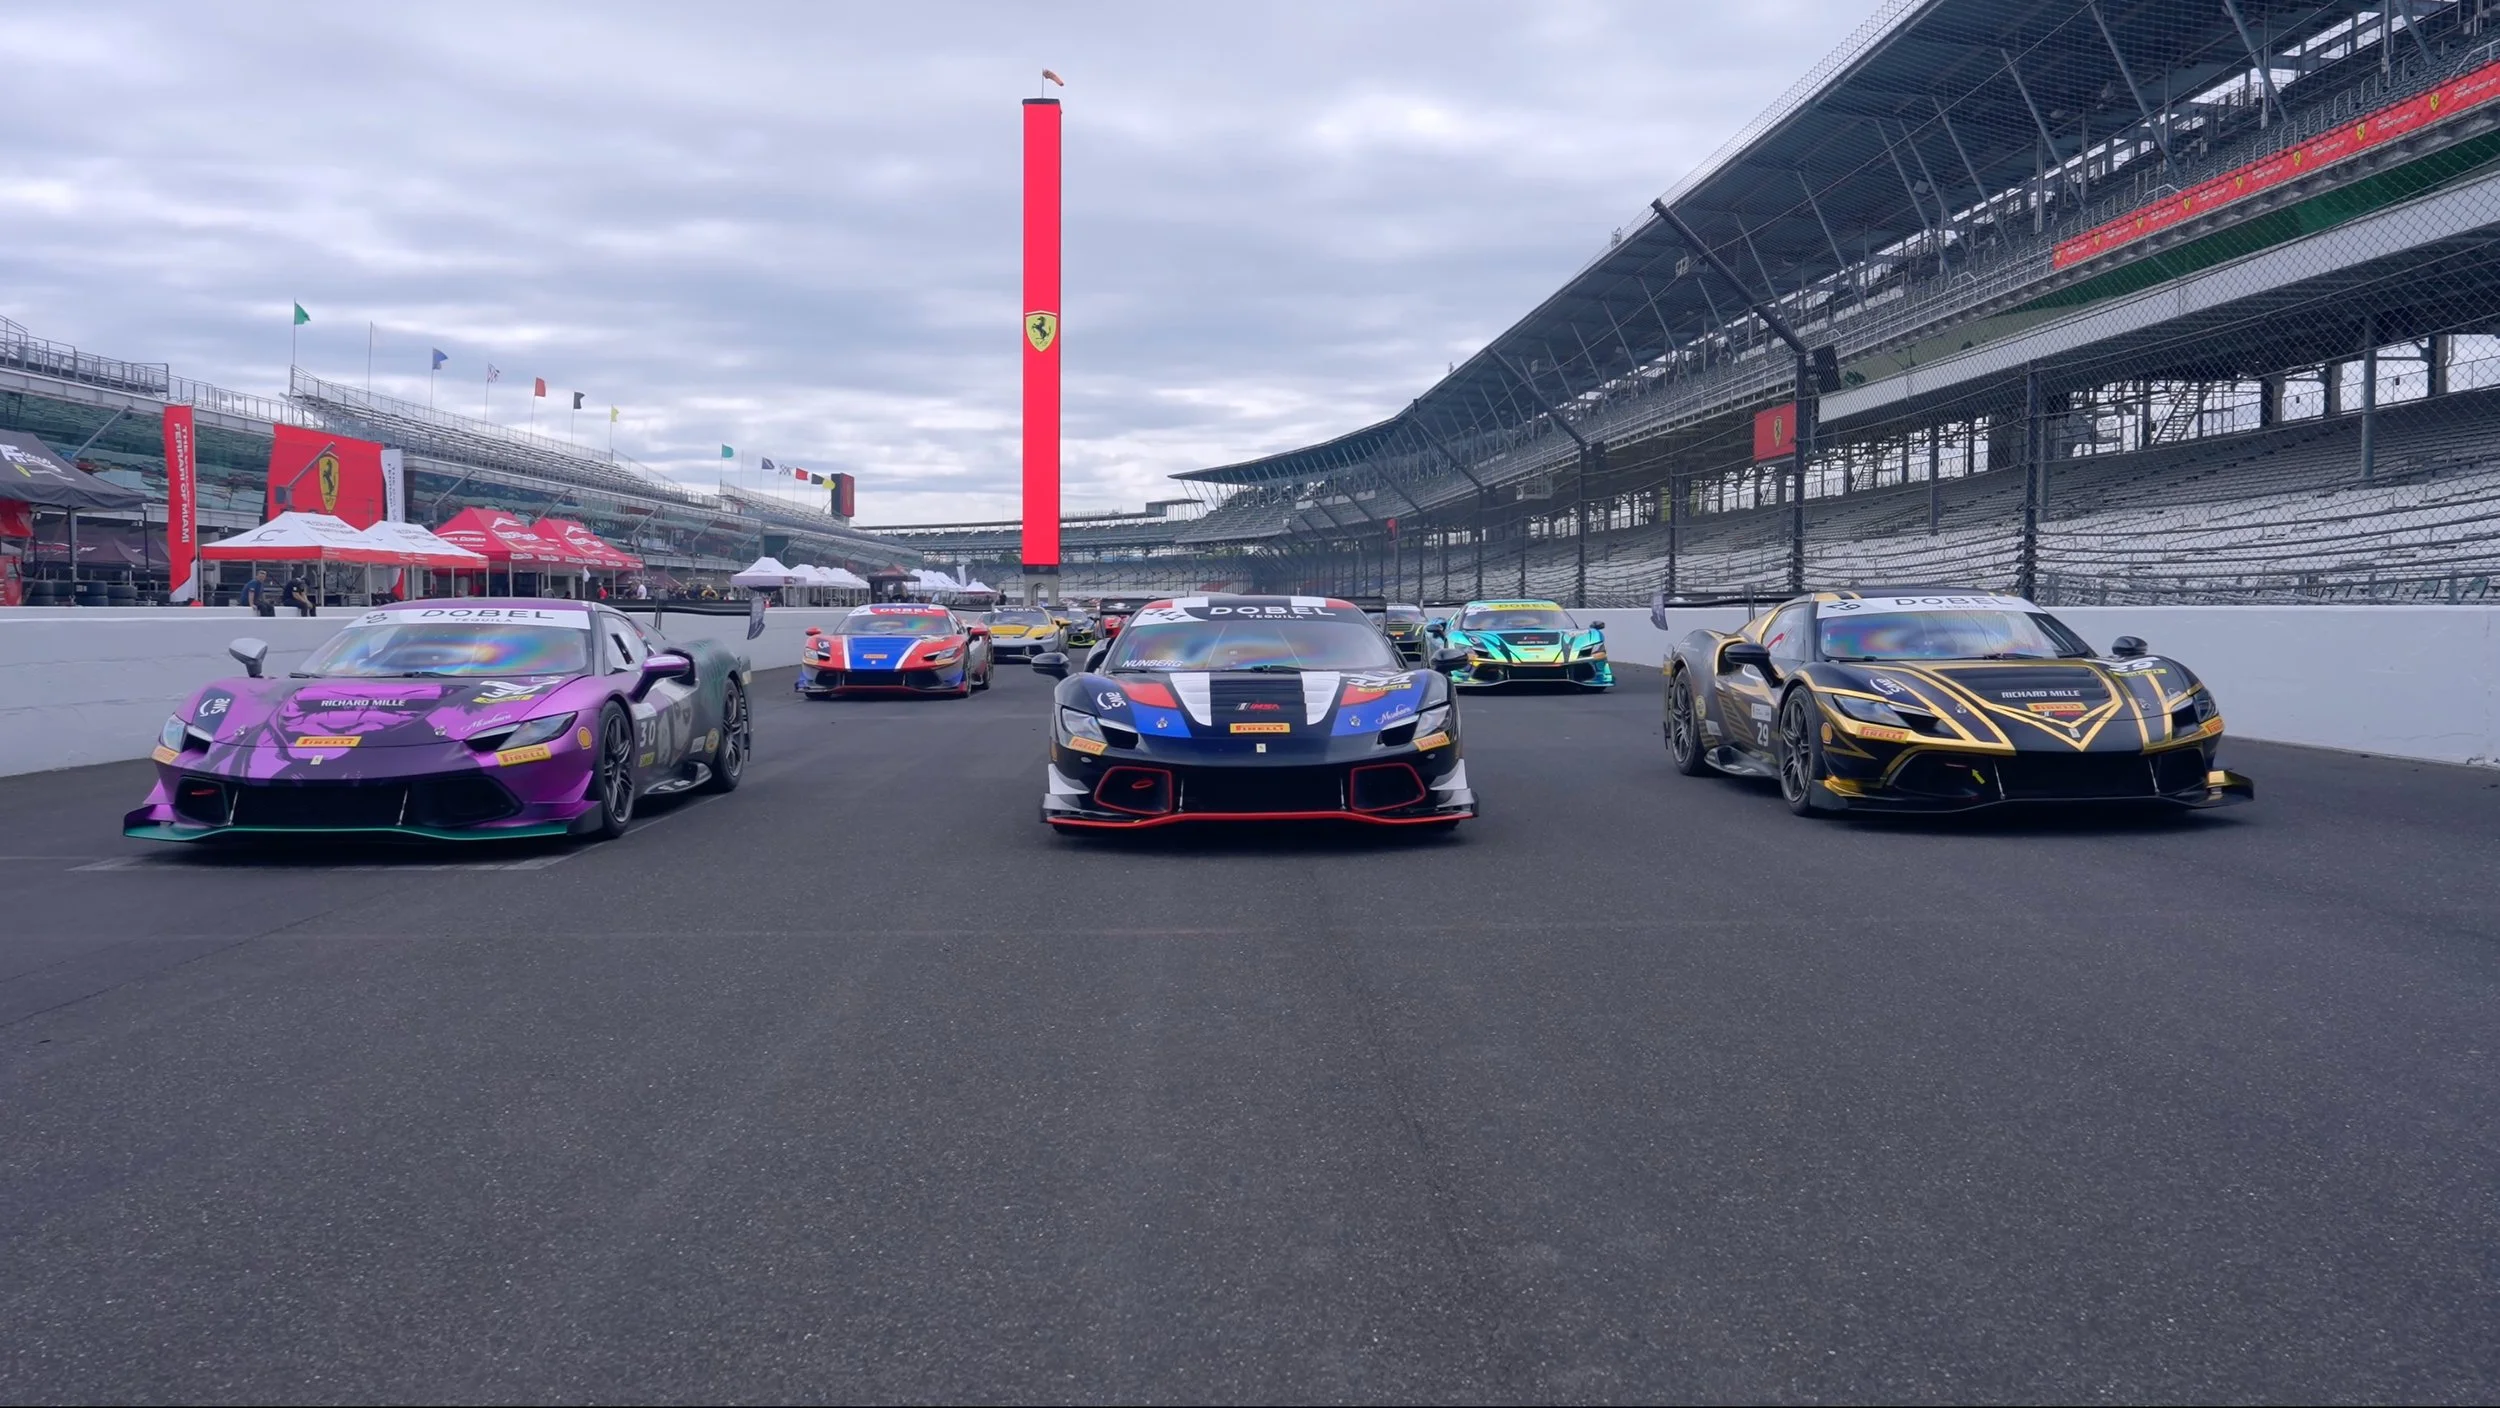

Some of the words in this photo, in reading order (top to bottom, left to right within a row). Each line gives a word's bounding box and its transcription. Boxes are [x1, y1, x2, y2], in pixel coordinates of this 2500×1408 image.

[173, 423, 186, 482] FERRARI
[180, 484, 188, 501] OF
[181, 504, 190, 543] MIAMI
[1826, 601, 1861, 611] 29
[1894, 597, 2014, 606] DOBEL
[421, 609, 555, 619] DOBEL
[1209, 606, 1337, 616] DOBEL
[1121, 659, 1184, 668] NUNBERG
[2001, 690, 2047, 699] RICHARD
[2049, 689, 2081, 697] MILLE
[320, 699, 370, 707] RICHARD
[372, 699, 407, 707] MILLE
[1106, 691, 1127, 708] aws
[2032, 703, 2082, 711] PIRELLI
[639, 719, 656, 748] 30
[1757, 721, 1769, 747] 29
[1861, 726, 1905, 740] PIRELLI
[302, 737, 354, 745] PIRELLI
[503, 746, 546, 763] PIRELLI
